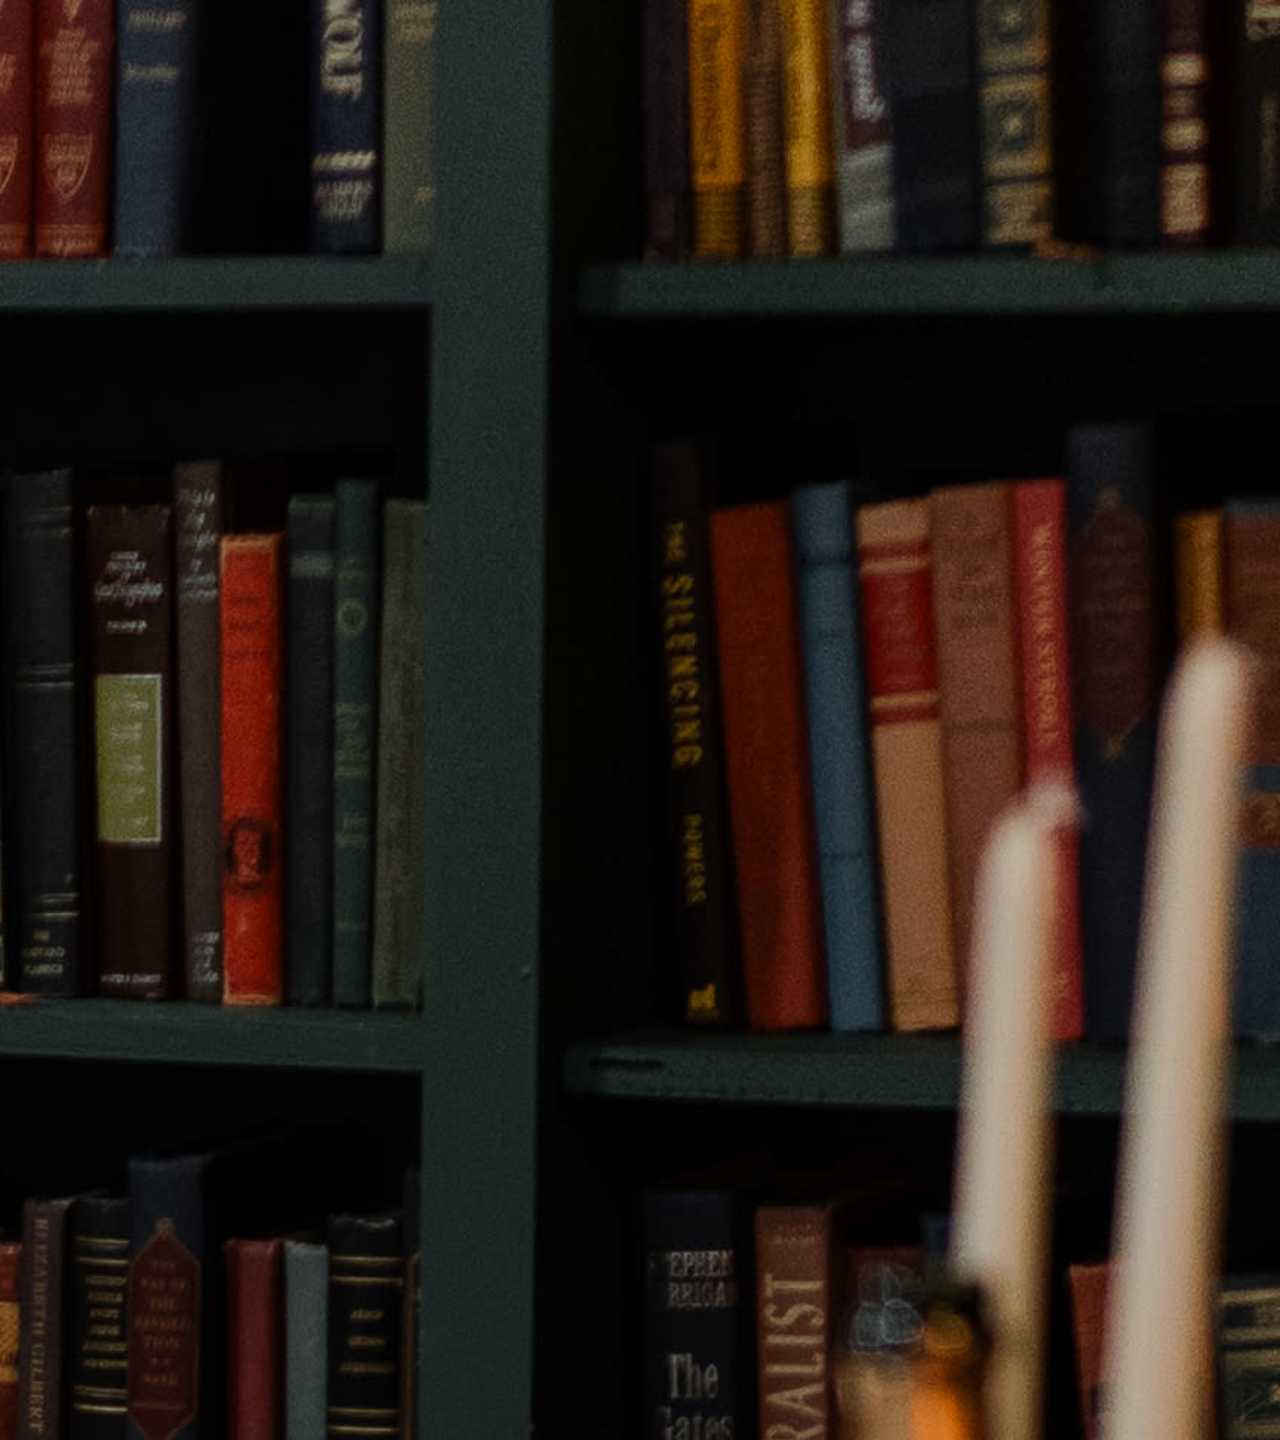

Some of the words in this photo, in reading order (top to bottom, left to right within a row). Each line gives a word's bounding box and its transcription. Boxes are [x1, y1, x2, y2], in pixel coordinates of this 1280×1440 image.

[662, 574, 704, 768] SILENCING
[681, 812, 708, 905] POWERS
[28, 1343, 48, 1433] GILBERT
[668, 1352, 719, 1400] The
